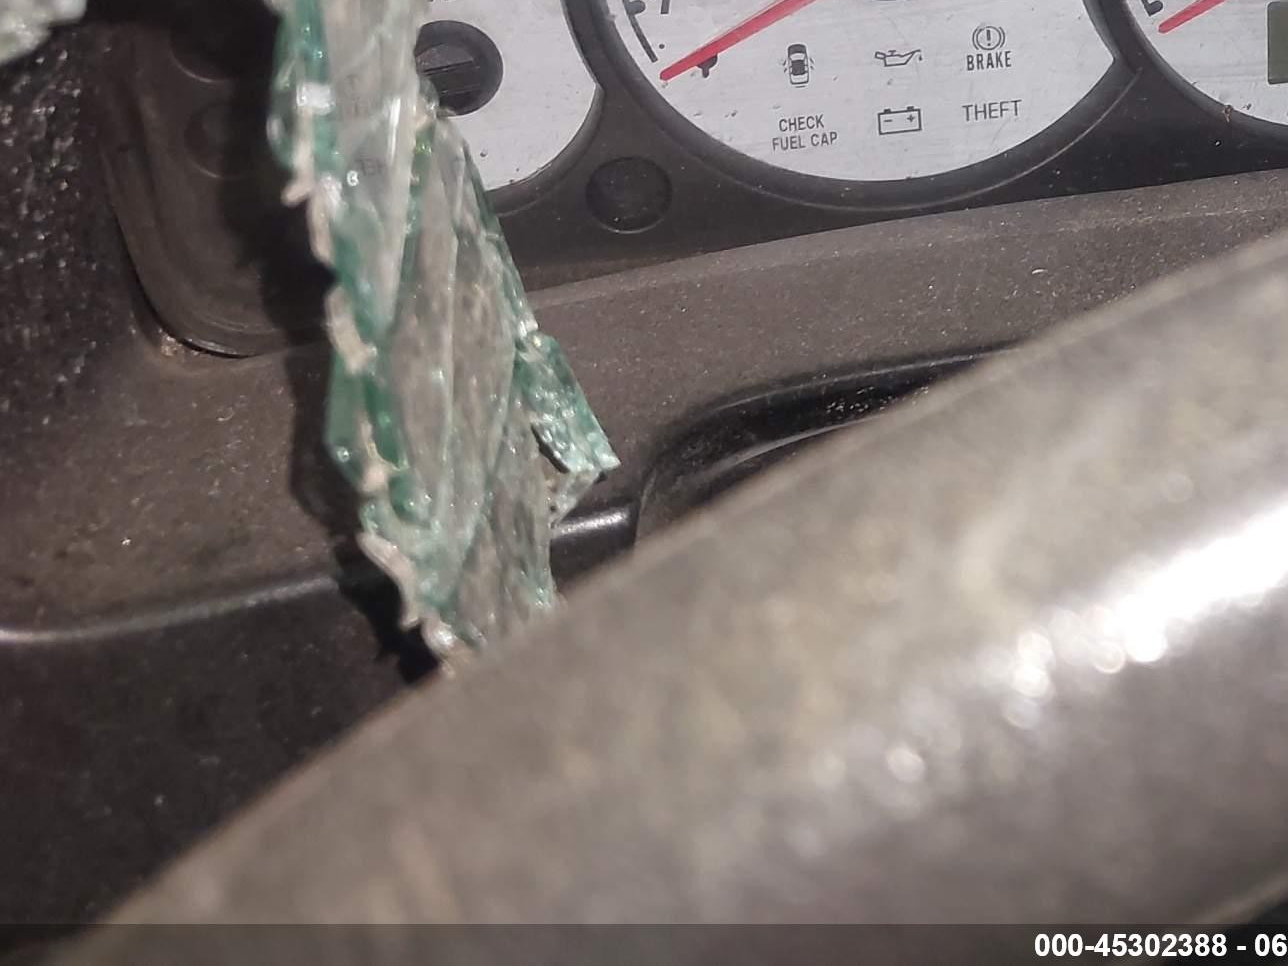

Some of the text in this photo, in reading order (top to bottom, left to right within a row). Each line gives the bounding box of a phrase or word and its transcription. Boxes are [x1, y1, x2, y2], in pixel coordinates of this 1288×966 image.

[965, 52, 1012, 72] BRAKE
[962, 99, 1023, 123] THEFT
[778, 114, 825, 132] CHECK
[771, 130, 838, 152] FUEL CAP
